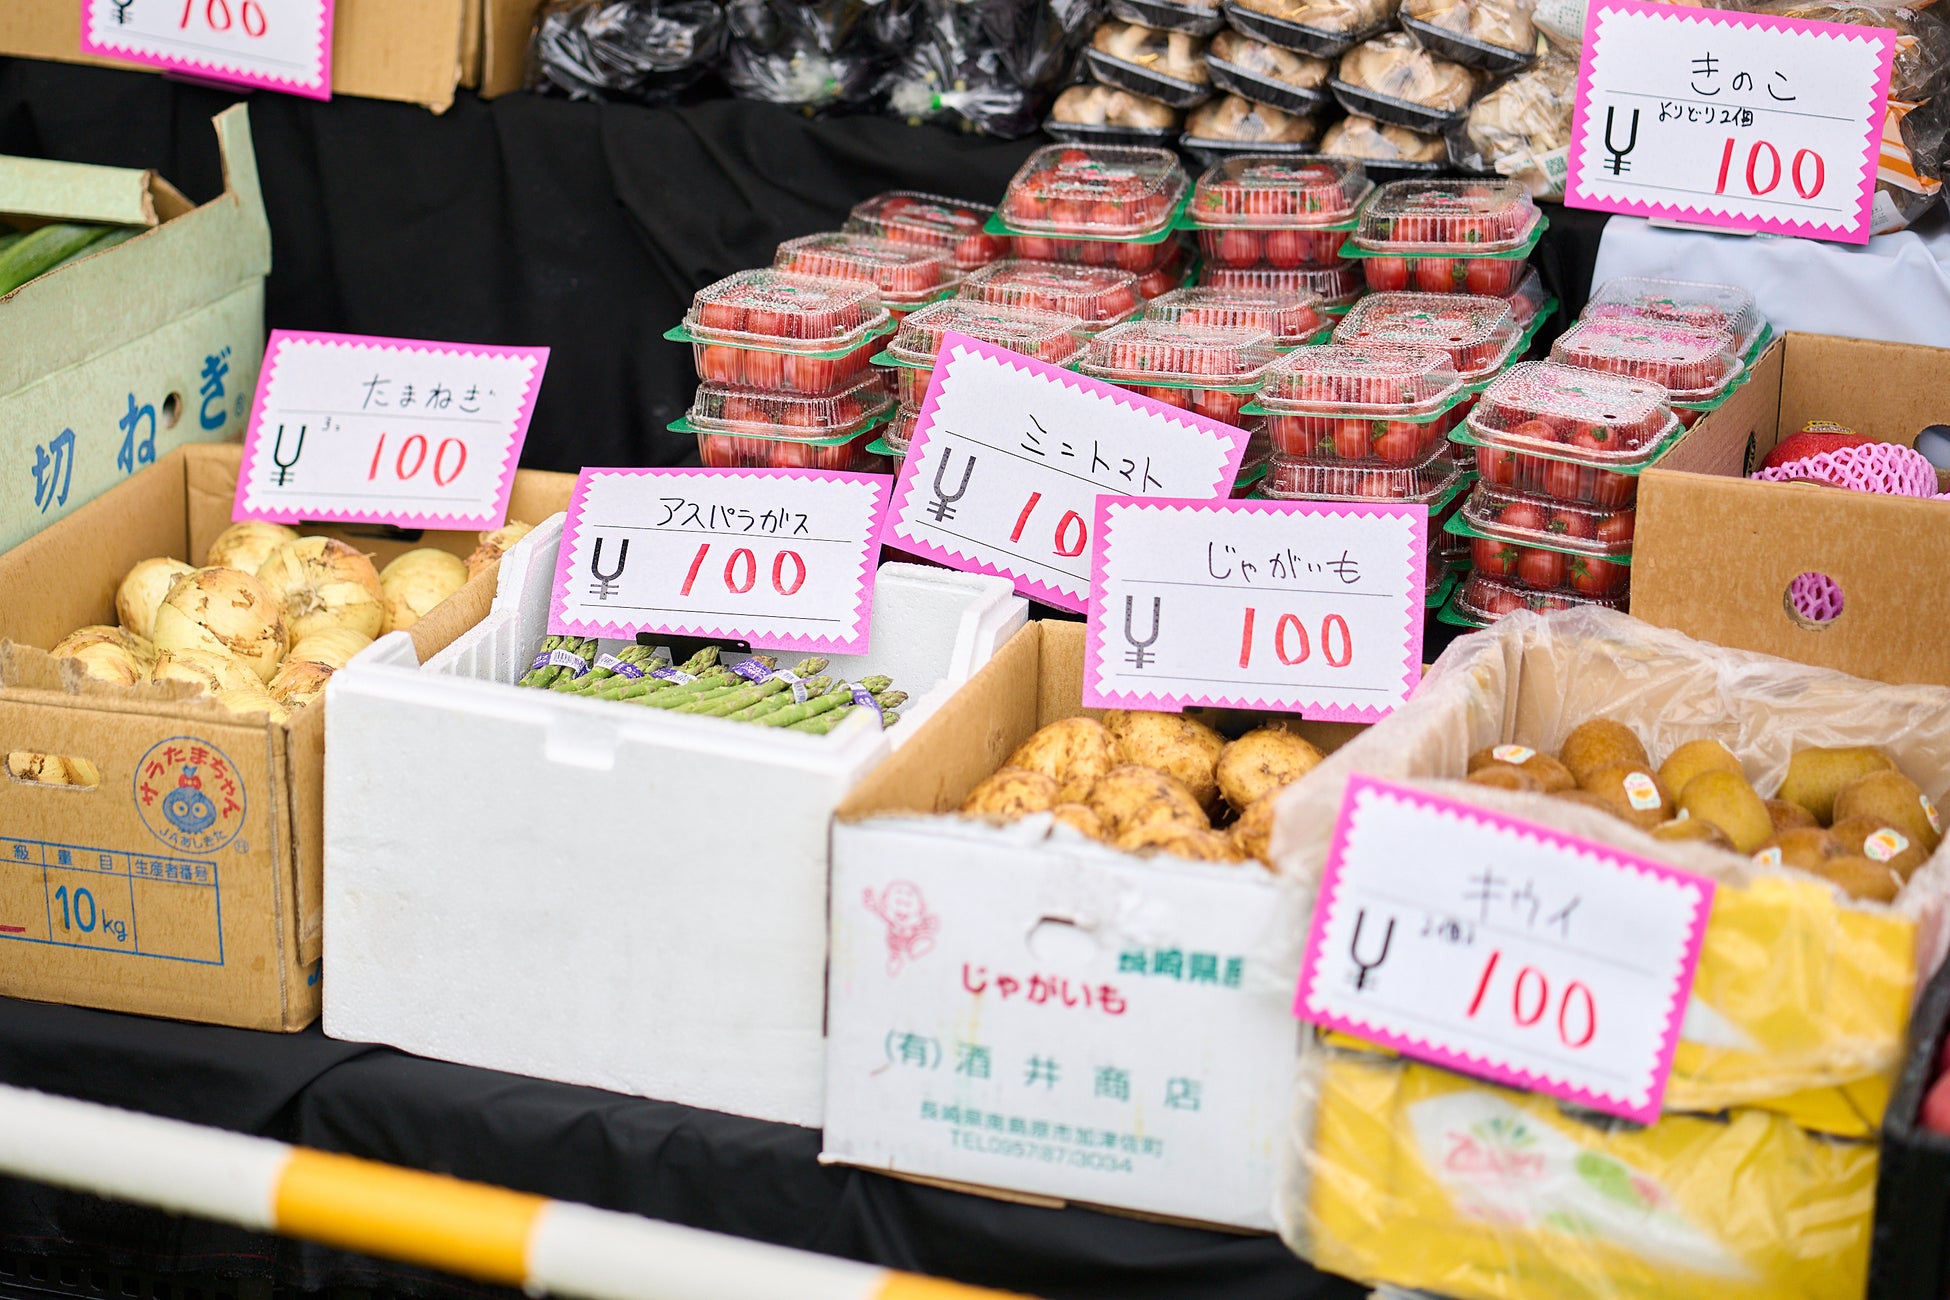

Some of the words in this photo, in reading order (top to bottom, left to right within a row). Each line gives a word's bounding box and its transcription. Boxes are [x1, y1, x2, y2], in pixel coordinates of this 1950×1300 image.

[179, 0, 267, 38] 100
[1691, 52, 1796, 101] きのこ
[1659, 102, 1754, 127] よりどり2個
[1604, 106, 1640, 175] ¥
[1715, 138, 1824, 199] 100
[362, 373, 496, 413] たまねぎ
[32, 346, 231, 514] 切ねぎ
[270, 424, 306, 486] ¥
[368, 432, 468, 488] 100
[1021, 414, 1162, 493] ミニトマト
[927, 447, 976, 523] ¥
[589, 537, 629, 600] ¥
[680, 543, 806, 596] 100
[1208, 541, 1362, 584] じゃがいも
[1124, 595, 1161, 668] ¥
[1239, 607, 1353, 669] 100
[140, 746, 241, 819] サラたまちゃん
[134, 858, 209, 882] 生産者番号
[1461, 865, 1582, 939] キウイ
[962, 962, 1127, 1015] じゃがいも
[1344, 907, 1396, 991] ¥
[1466, 949, 1596, 1049] 100
